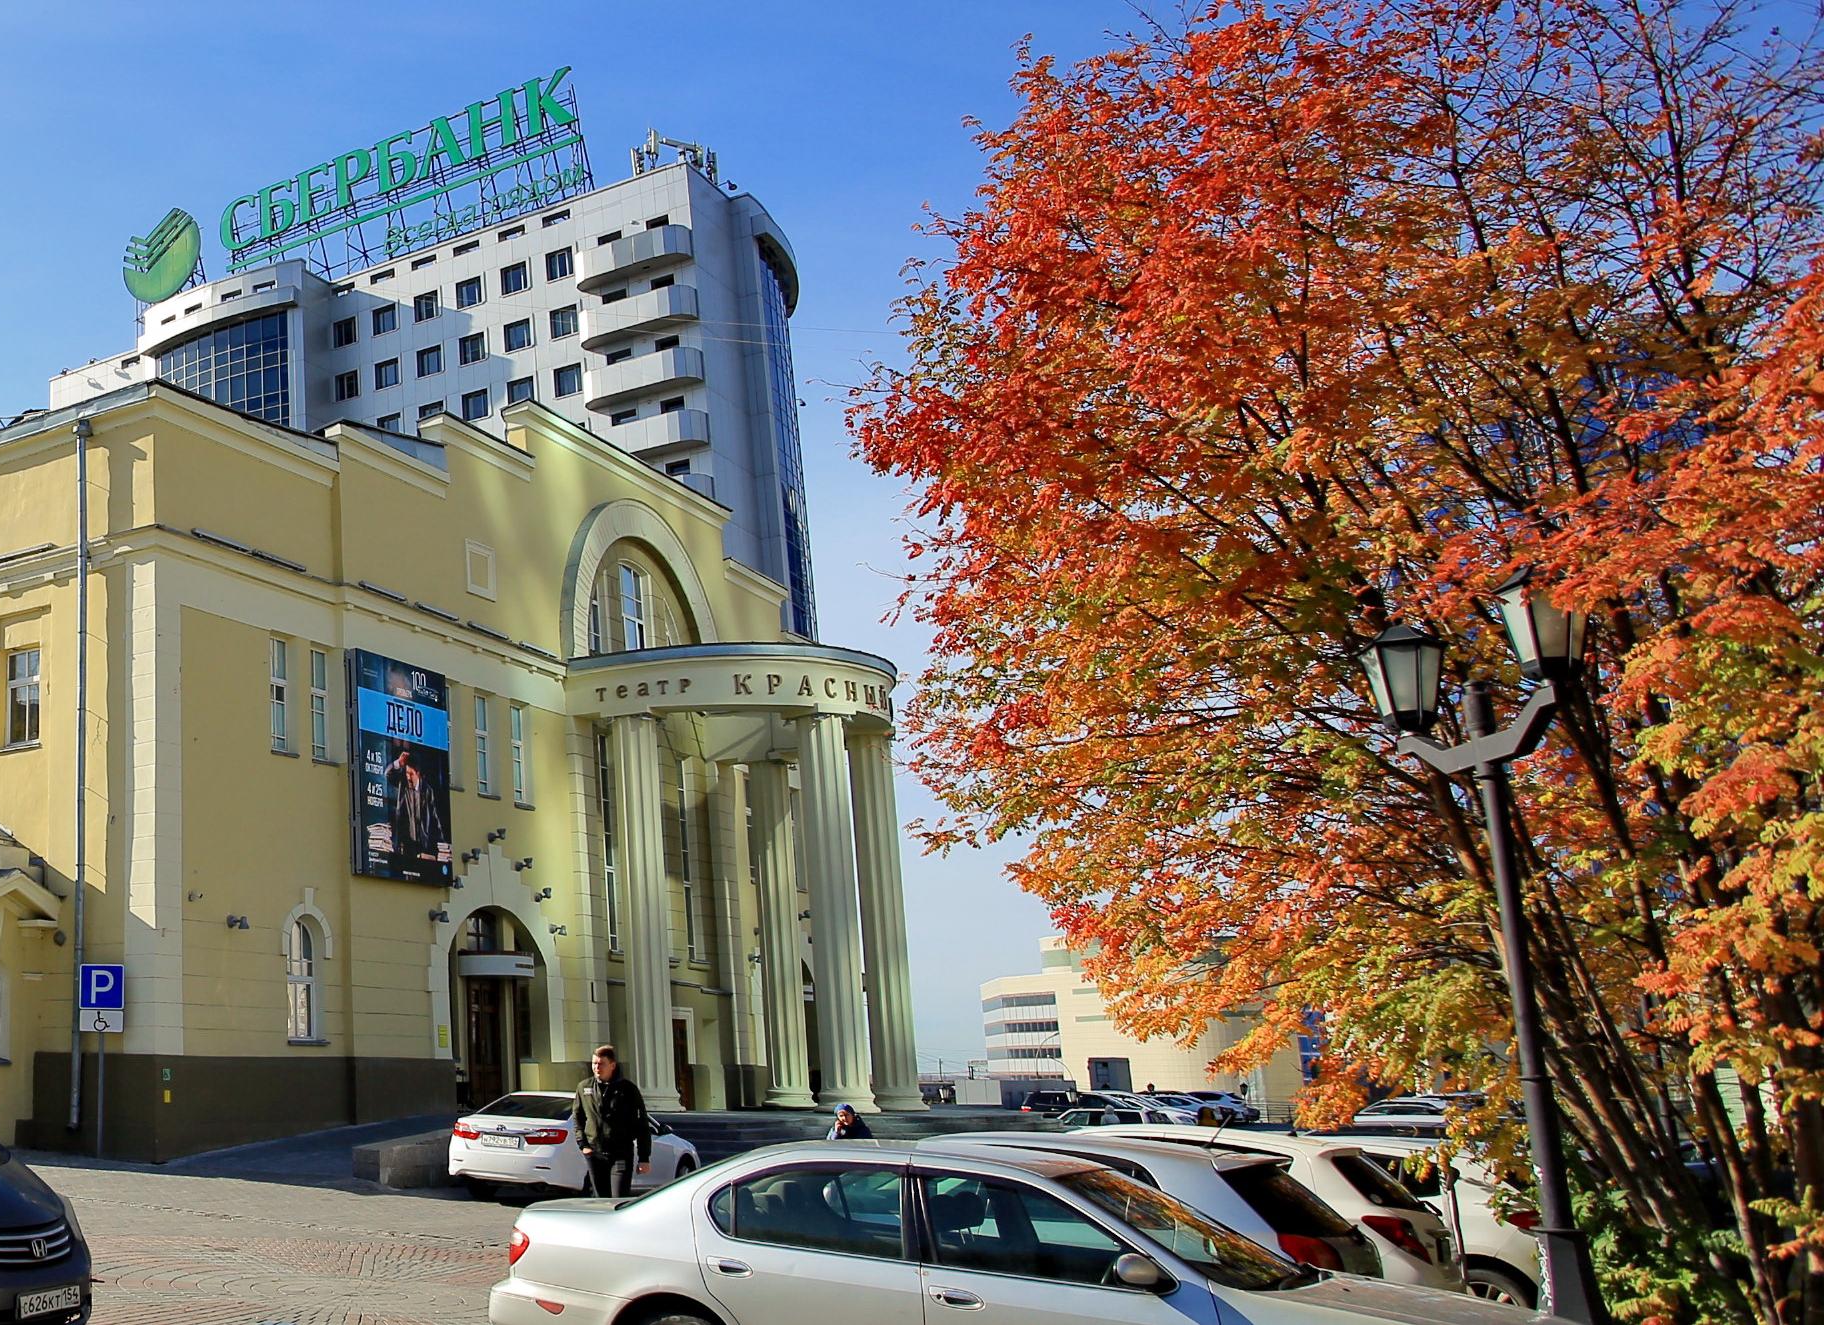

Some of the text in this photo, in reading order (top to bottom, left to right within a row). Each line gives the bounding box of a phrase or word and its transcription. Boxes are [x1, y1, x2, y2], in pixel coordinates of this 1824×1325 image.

[220, 65, 578, 252] СБЕРБАНК
[384, 164, 585, 255] Всегда рядом
[386, 701, 423, 738] ДЕЛО
[90, 969, 115, 1004] P
[63, 1287, 79, 1302] 154
